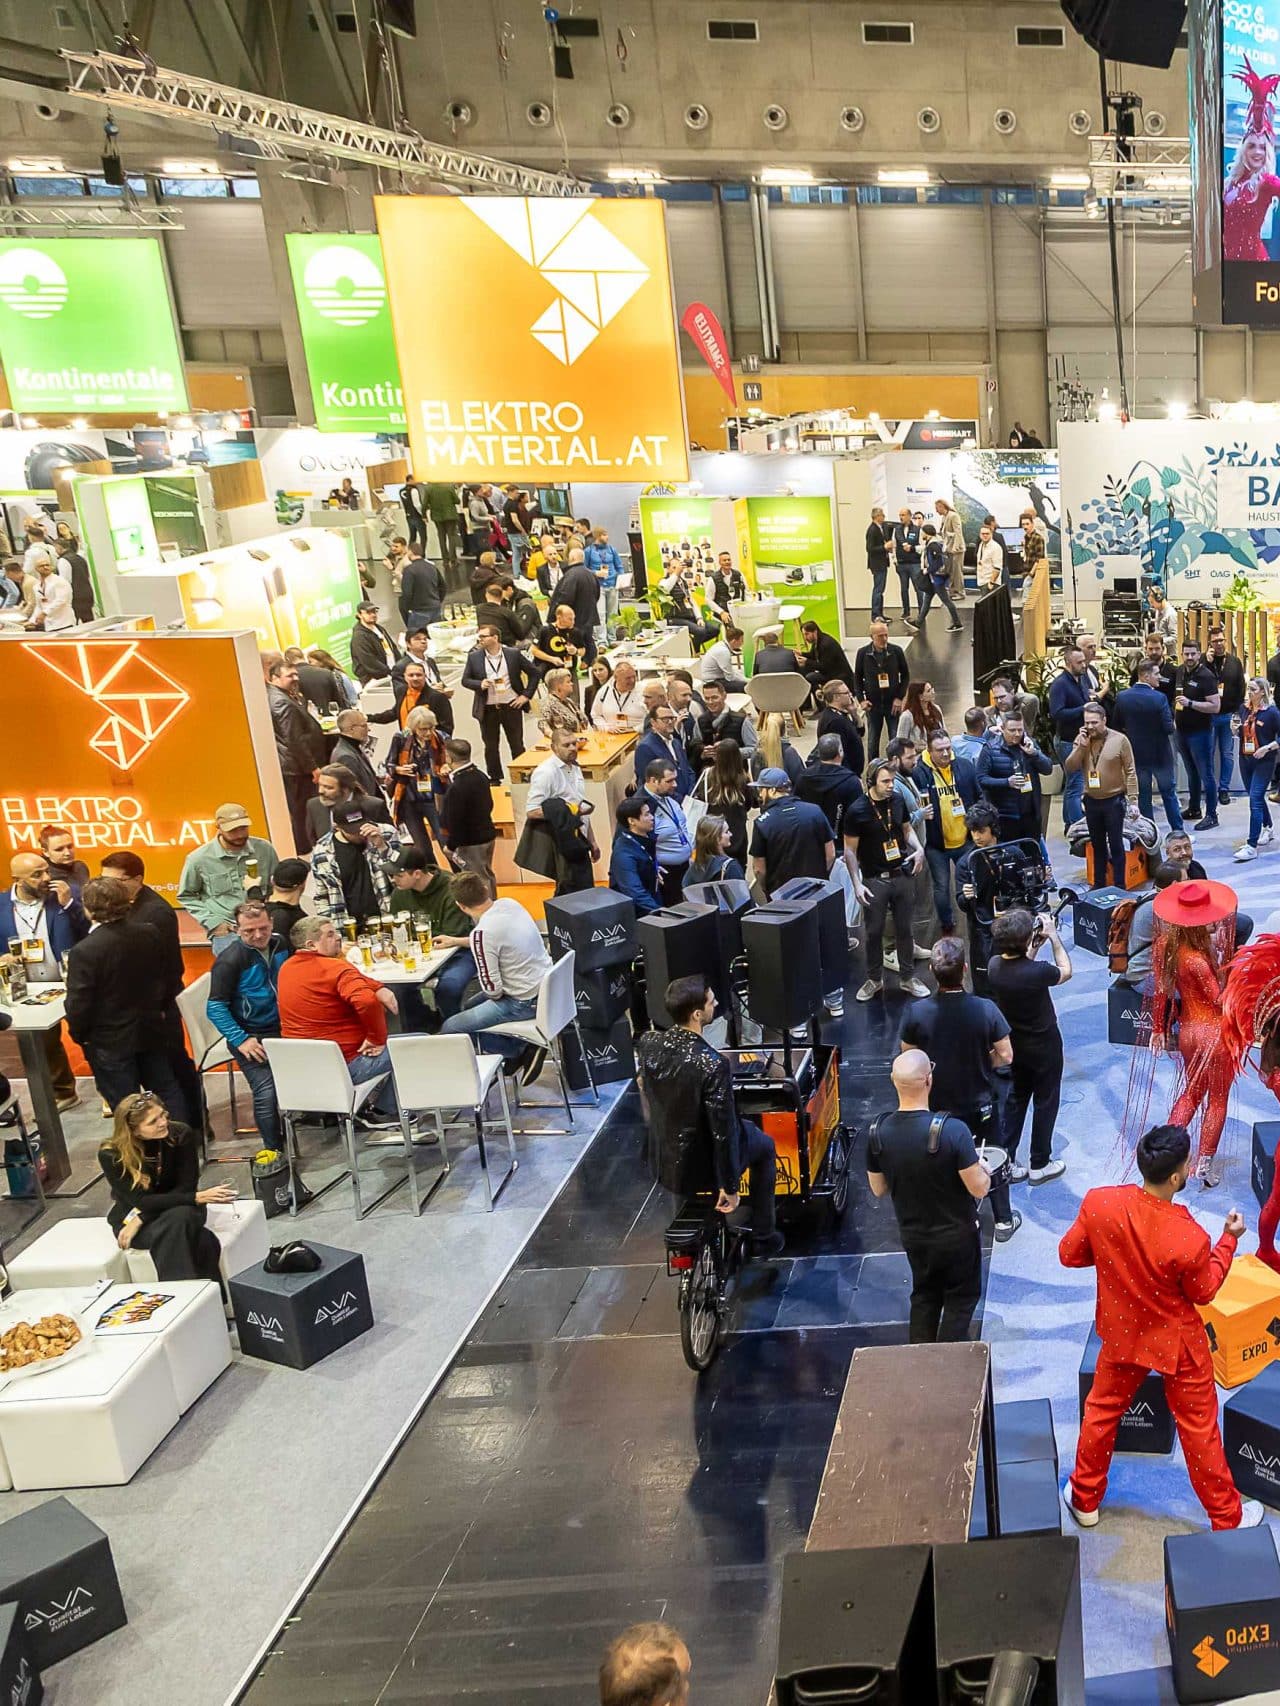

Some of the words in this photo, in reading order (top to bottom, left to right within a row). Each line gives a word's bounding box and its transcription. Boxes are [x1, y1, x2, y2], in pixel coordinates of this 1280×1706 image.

[13, 366, 174, 390] Kontinentale
[421, 401, 584, 433] ELEKTRO
[427, 436, 669, 467] MATERIAL.AT
[2, 797, 142, 823] ELEKTRO
[591, 923, 626, 942] ALVA
[315, 1291, 357, 1325] ALVA
[247, 1311, 283, 1332] ALVA
[1242, 1341, 1268, 1361] EXPO
[24, 1586, 93, 1631] ALVA
[1226, 1624, 1270, 1646] EXPO
